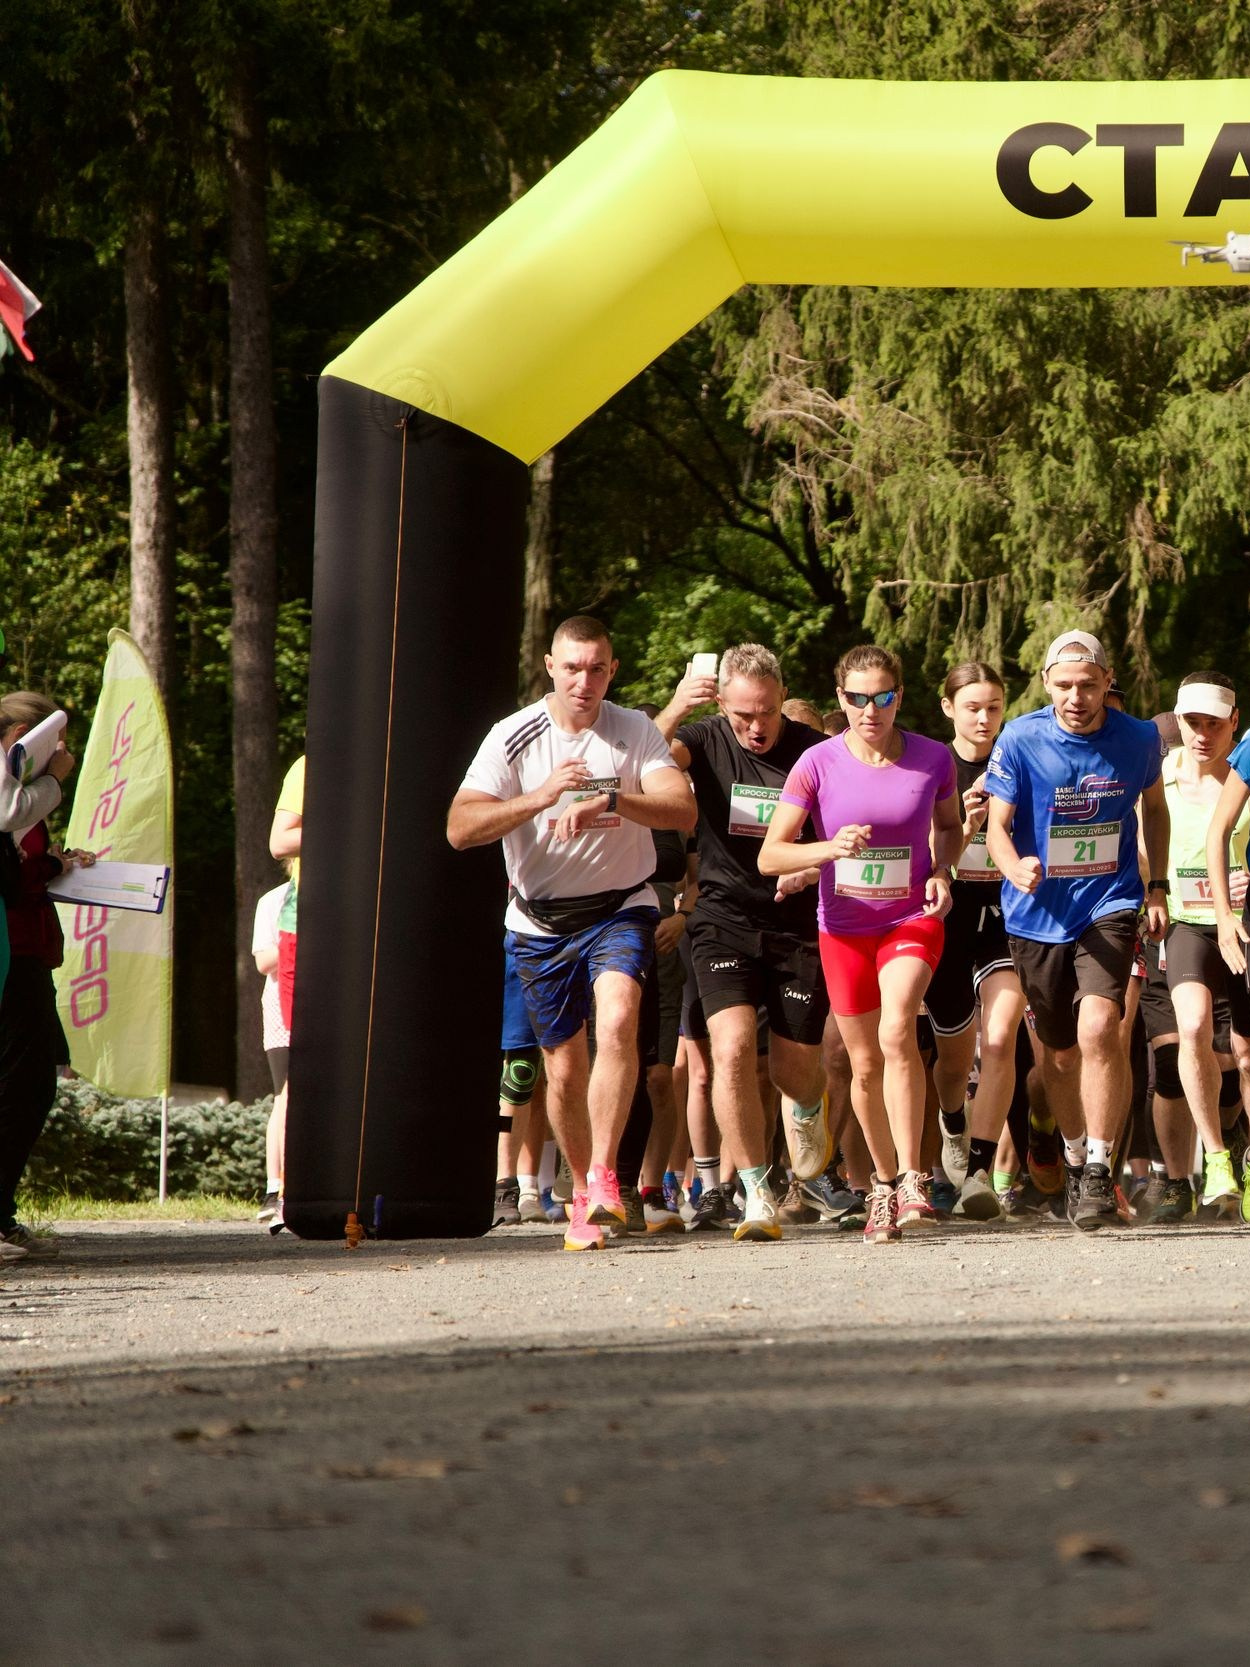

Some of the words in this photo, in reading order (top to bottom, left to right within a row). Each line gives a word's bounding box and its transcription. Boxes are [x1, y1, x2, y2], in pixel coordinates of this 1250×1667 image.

[588, 780, 615, 790] ДУБКИ
[1055, 786, 1075, 794] ЗАБЕГ
[739, 788, 768, 798] КРОСС
[1054, 789, 1125, 801] ПРОМЫШЛЕННОСТИ
[1054, 799, 1085, 807] МОСКВЫ
[1057, 828, 1087, 836] КРОСС
[1087, 826, 1114, 836] ДУБКИ
[874, 851, 903, 860] ДУБКИ
[1073, 840, 1097, 862] 21
[860, 863, 885, 885] 47
